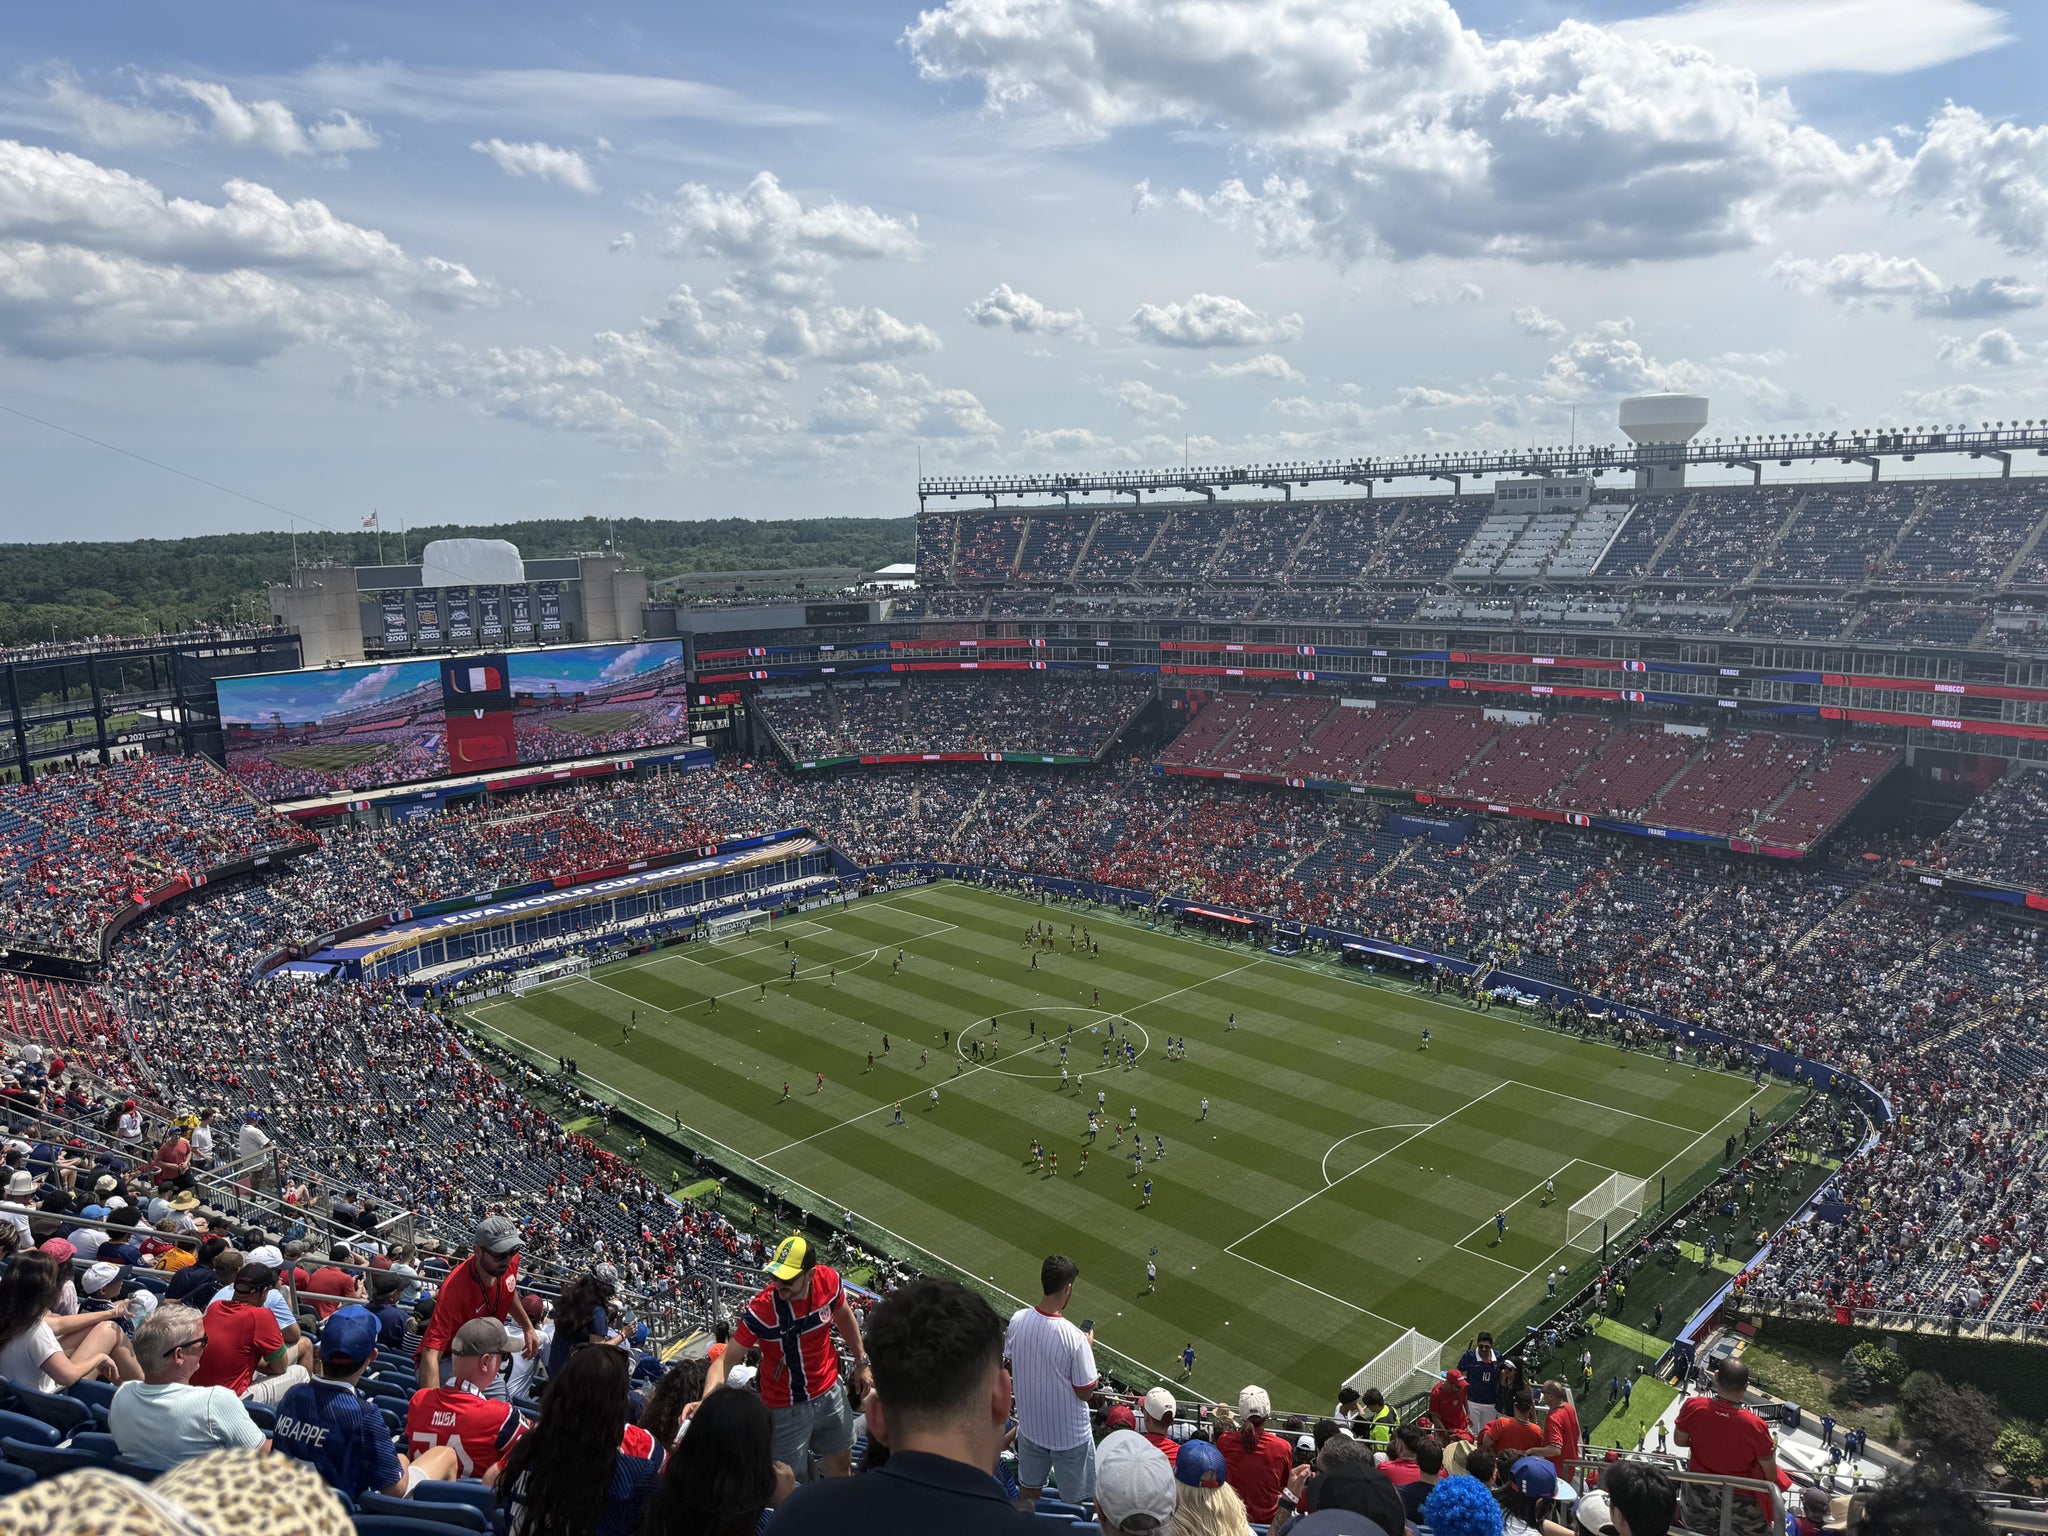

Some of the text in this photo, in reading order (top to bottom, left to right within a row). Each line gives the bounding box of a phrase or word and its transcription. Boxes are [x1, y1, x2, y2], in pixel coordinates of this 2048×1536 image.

[1935, 684, 1965, 694] MOROCCO
[474, 709, 484, 719] V
[1932, 719, 1961, 729] MOROCCO
[128, 734, 145, 742] 2021
[1648, 828, 1666, 837] FRANCE
[873, 878, 927, 894] ADI FOUNDATION
[1920, 876, 1942, 887] FRANCE
[443, 908, 504, 923] FIFA
[502, 888, 593, 910] WORLD
[594, 877, 641, 890] CUP
[798, 903, 807, 913] THE
[807, 900, 819, 911] FINAL
[820, 898, 832, 908] HALF
[710, 919, 750, 934] FOUNDATION
[559, 951, 628, 977] ADI FOUNDATION
[454, 974, 540, 1007] THE FINAL HALF TIME SHOW
[1626, 1010, 1641, 1019] FIFA
[1483, 1372, 1491, 1381] 10
[431, 1411, 456, 1426] MUSA
[275, 1414, 329, 1447] MBAPPE
